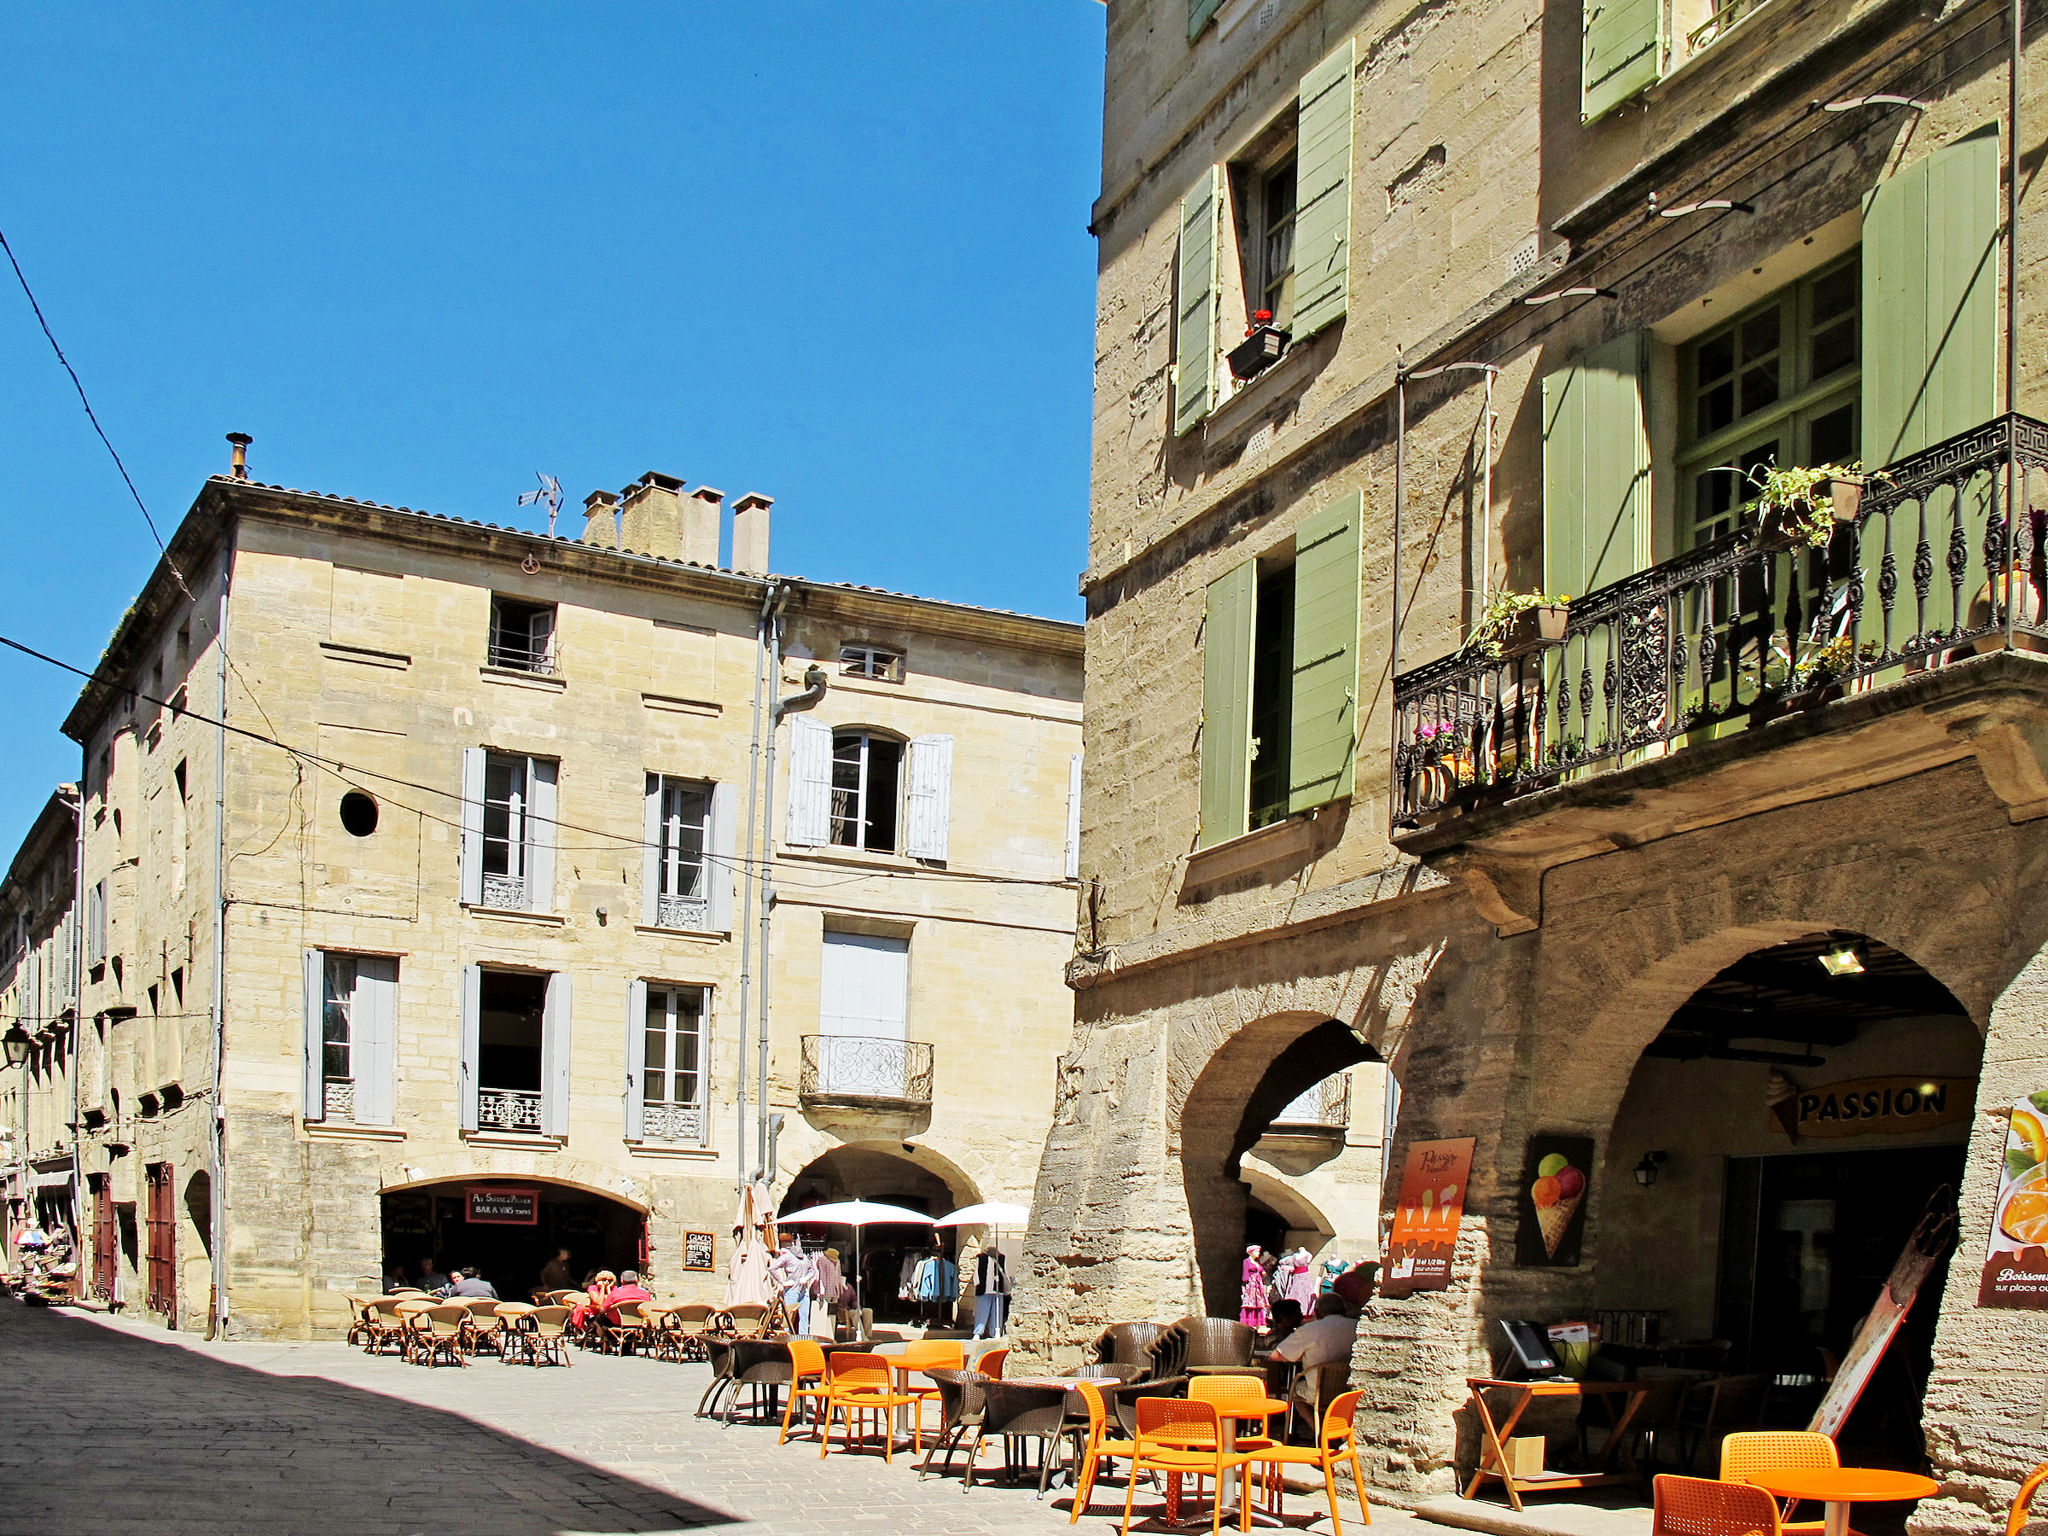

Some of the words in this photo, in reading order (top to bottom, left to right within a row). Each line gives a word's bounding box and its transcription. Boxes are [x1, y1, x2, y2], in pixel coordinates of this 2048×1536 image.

[1799, 1084, 1947, 1121] PASSION
[475, 1205, 491, 1214] BAR
[2009, 1284, 2037, 1293] place
